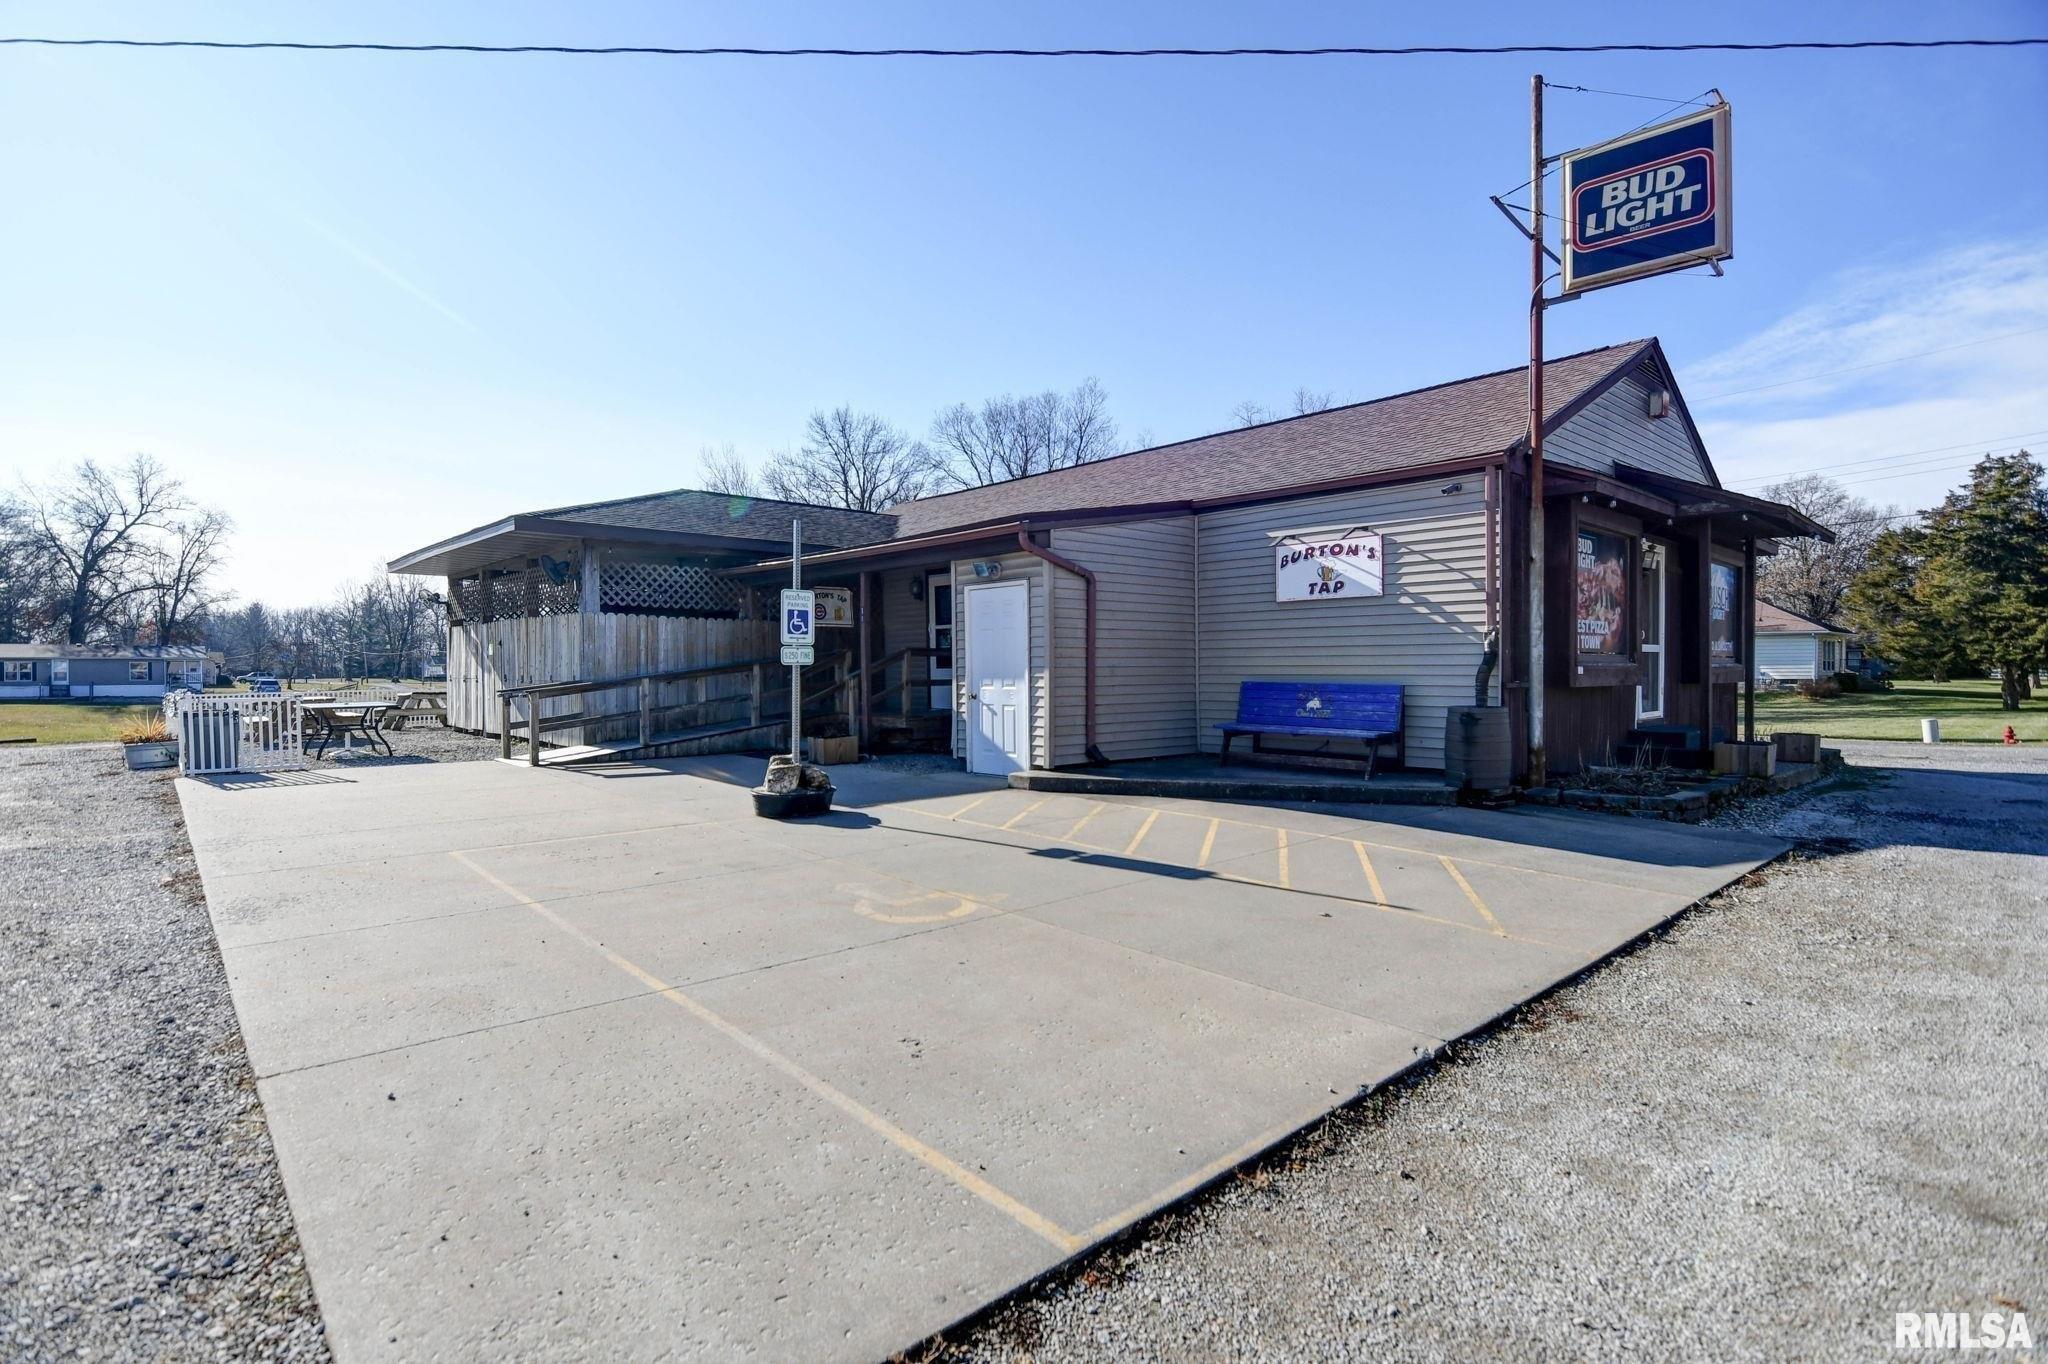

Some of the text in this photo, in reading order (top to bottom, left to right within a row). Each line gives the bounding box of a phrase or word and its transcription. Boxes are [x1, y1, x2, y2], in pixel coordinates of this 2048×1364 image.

[1601, 165, 1686, 209] BUD
[1585, 183, 1702, 238] LIGHT
[1577, 537, 1593, 554] BUD
[1280, 543, 1377, 569] BURTON'S
[1577, 552, 1596, 570] IGHT
[1308, 580, 1345, 595] TAP
[785, 593, 811, 602] RESERVED
[787, 601, 809, 609] PARKING
[1577, 619, 1609, 635] EST PIZZA
[1580, 635, 1601, 649] TOWN
